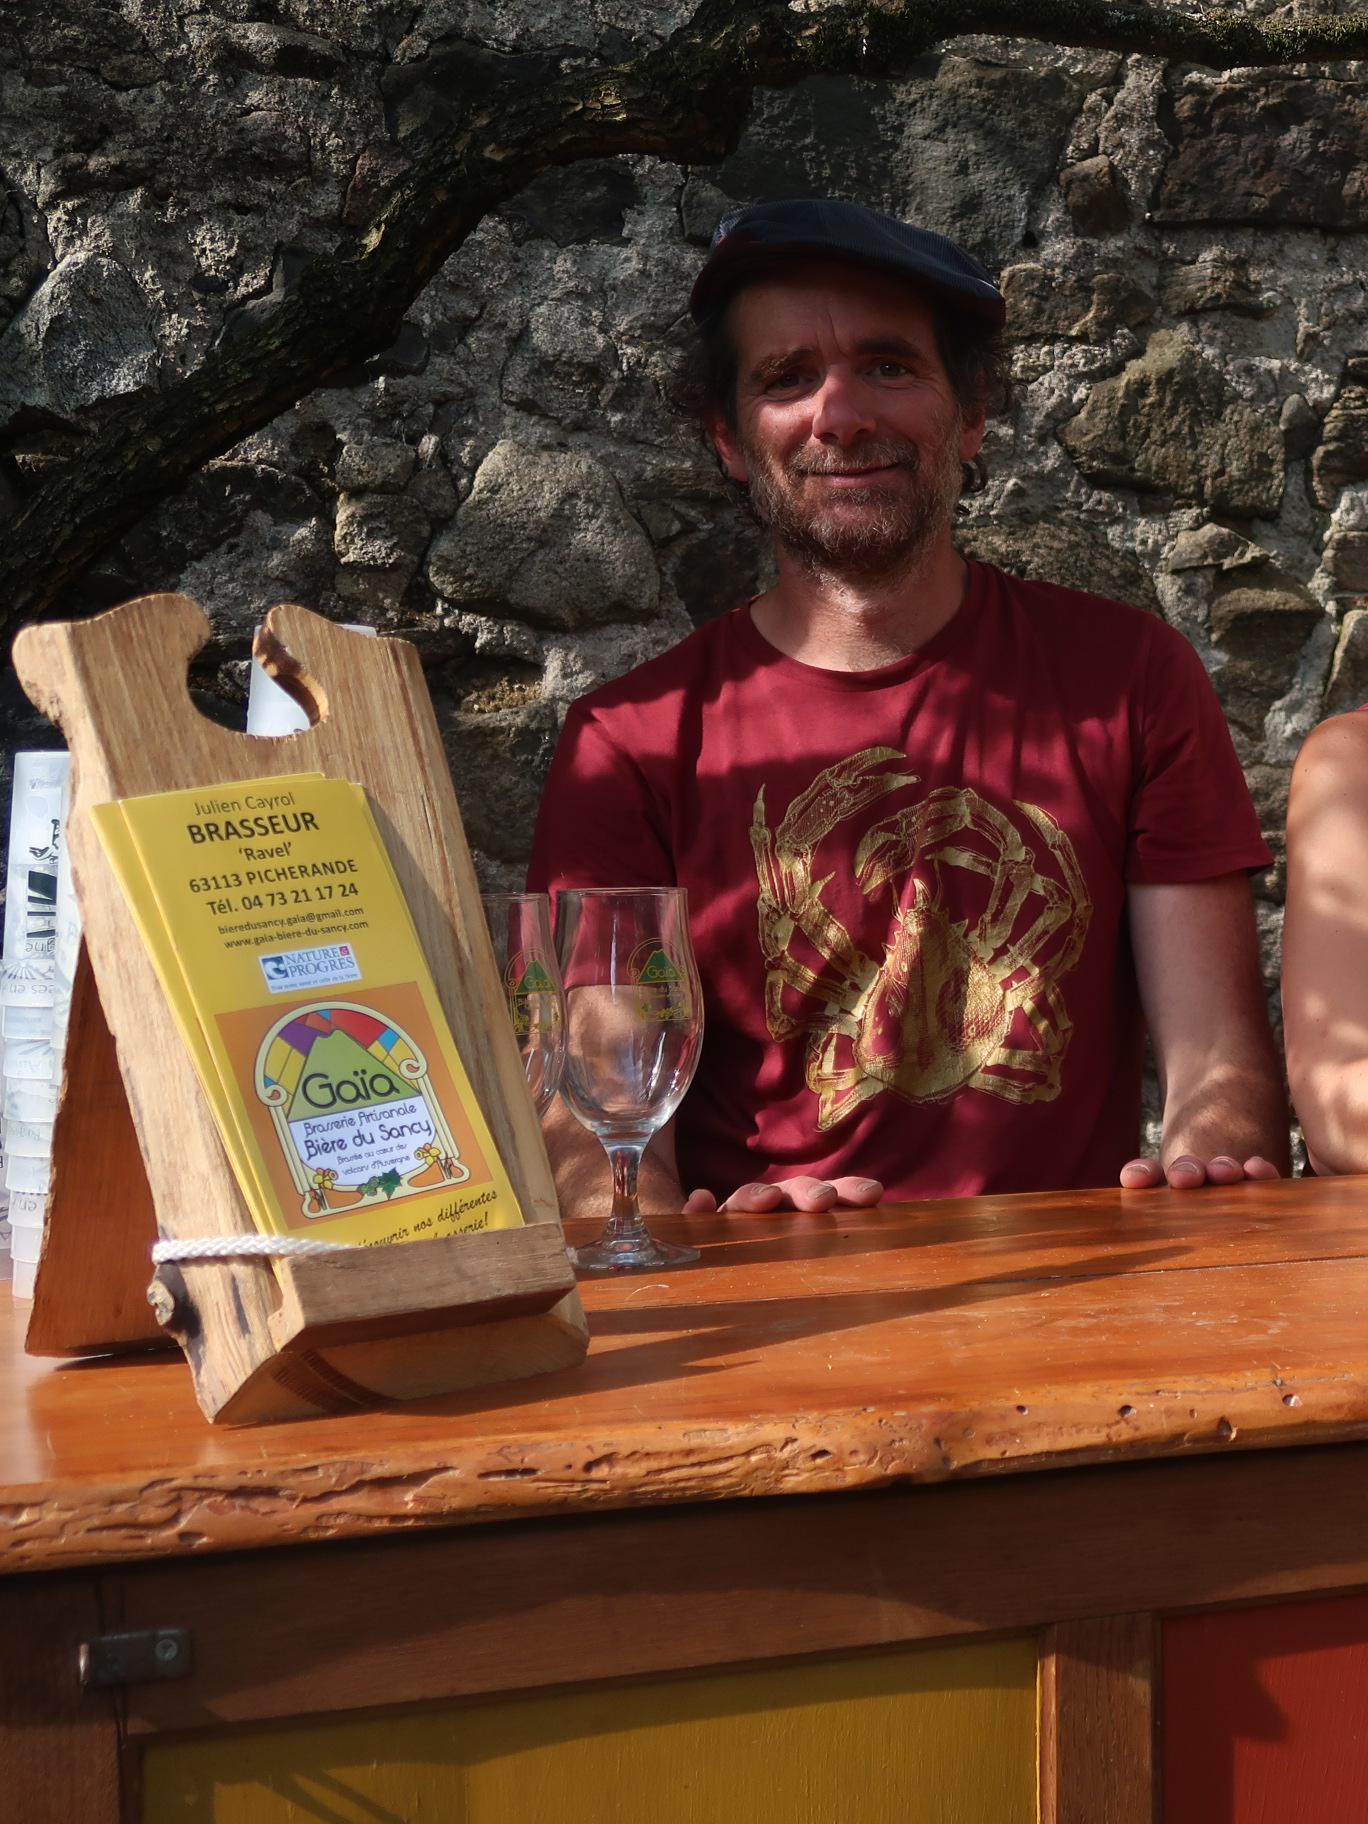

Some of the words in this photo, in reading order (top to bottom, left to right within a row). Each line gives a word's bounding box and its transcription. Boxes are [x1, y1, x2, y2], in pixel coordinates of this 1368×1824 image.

[194, 799, 242, 816] Julien
[245, 792, 296, 811] Cayrol
[187, 812, 320, 844] BRASSEUR
[189, 873, 243, 893] 63113
[245, 859, 358, 885] PICHERANDE
[206, 899, 238, 916] Tél.
[241, 895, 264, 910] 04
[265, 892, 288, 907] 73
[291, 889, 312, 904] 21
[315, 885, 333, 900] 17
[338, 883, 359, 898] 24
[217, 907, 364, 934] bieredusancy.gaia@gmail.com
[224, 921, 369, 948] www.gaia-biere-du-sancy.com
[285, 947, 340, 965] NATURE
[302, 1069, 400, 1109] Gaïa
[303, 1116, 356, 1138] Brasserie
[358, 1102, 417, 1127] Artisanale
[304, 1137, 348, 1161] Bière
[352, 1129, 376, 1147] du
[378, 1120, 432, 1141] Sancy
[365, 1151, 374, 1159] au
[396, 1143, 407, 1152] des
[413, 1217, 434, 1232] nos
[437, 1190, 498, 1223] différentes
